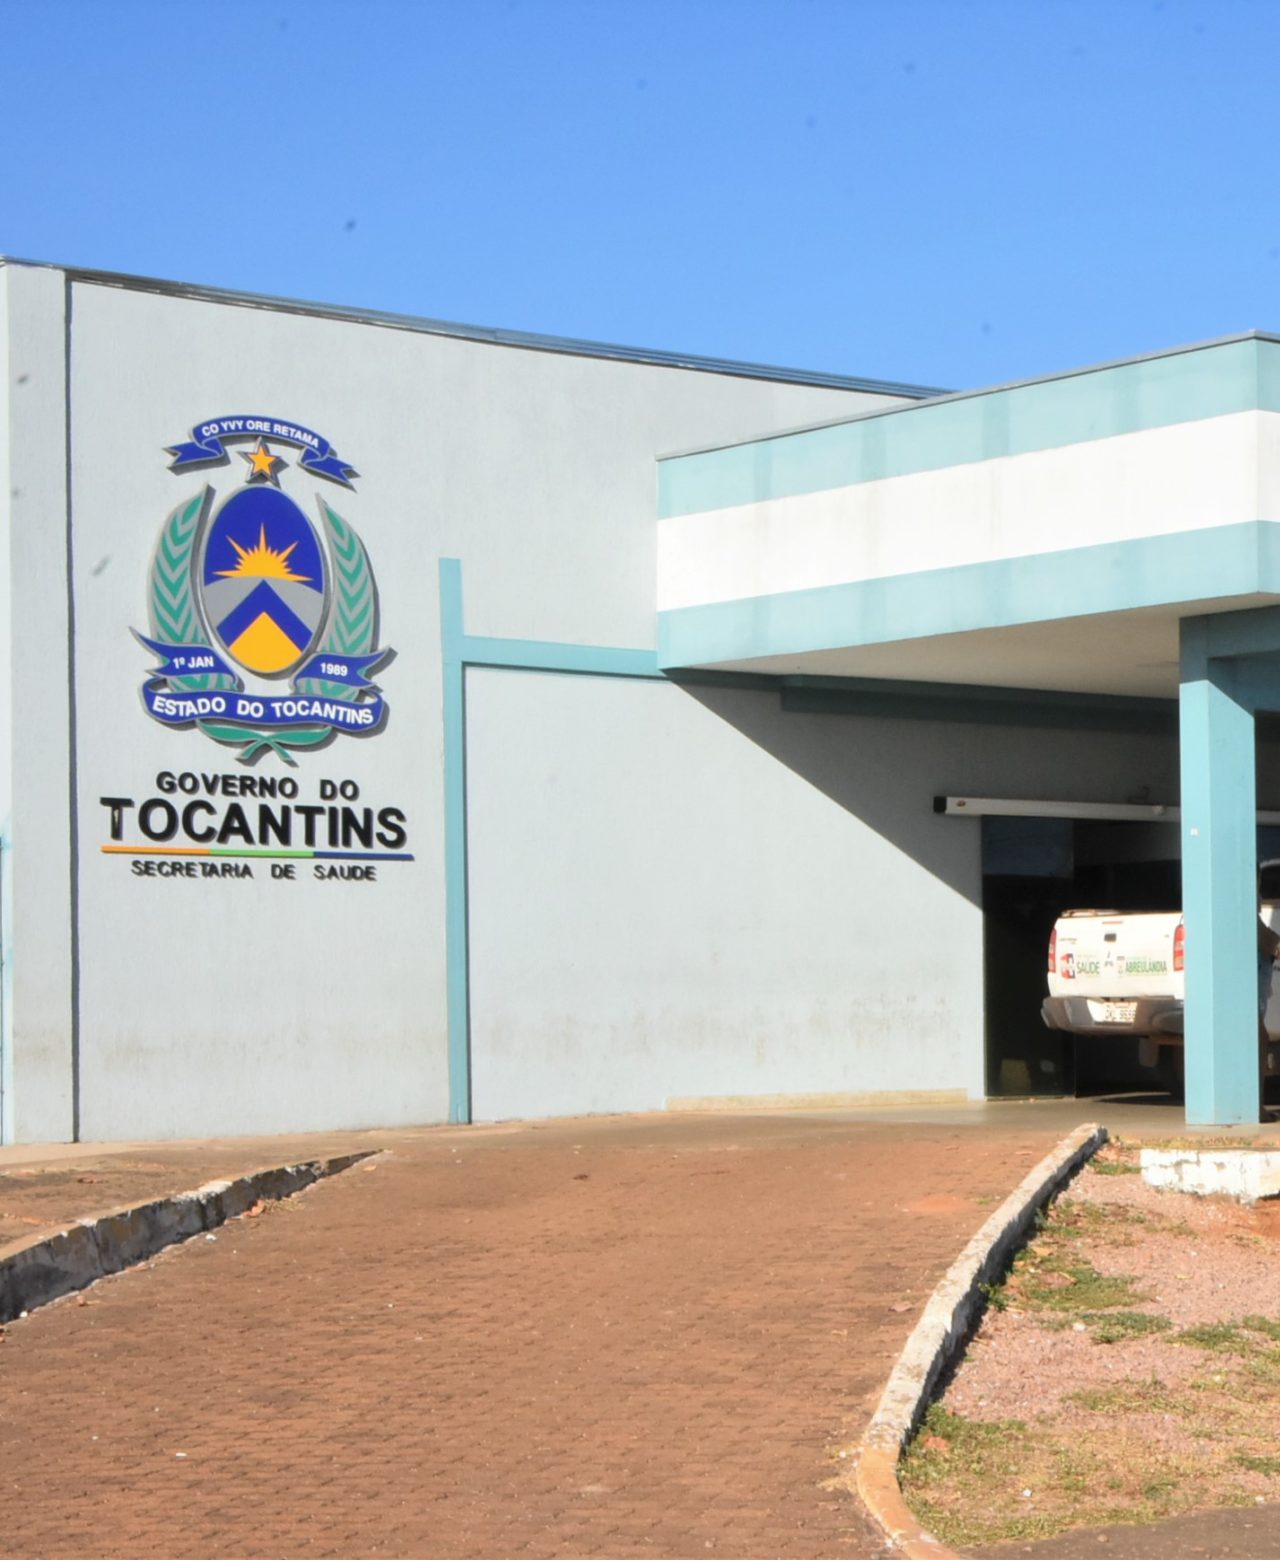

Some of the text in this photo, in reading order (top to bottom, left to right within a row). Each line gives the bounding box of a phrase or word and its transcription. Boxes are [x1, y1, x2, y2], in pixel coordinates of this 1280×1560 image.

[202, 420, 319, 447] CO YVY ORE RETAMA
[188, 656, 214, 668] JAN
[320, 662, 348, 676] 1989
[152, 697, 374, 724] ESTADO DO TOCANTINS
[156, 771, 360, 801] GOVERNO DO
[100, 797, 407, 849] TOCANTINS
[131, 860, 377, 881] SECRETARIA DE SAUDE
